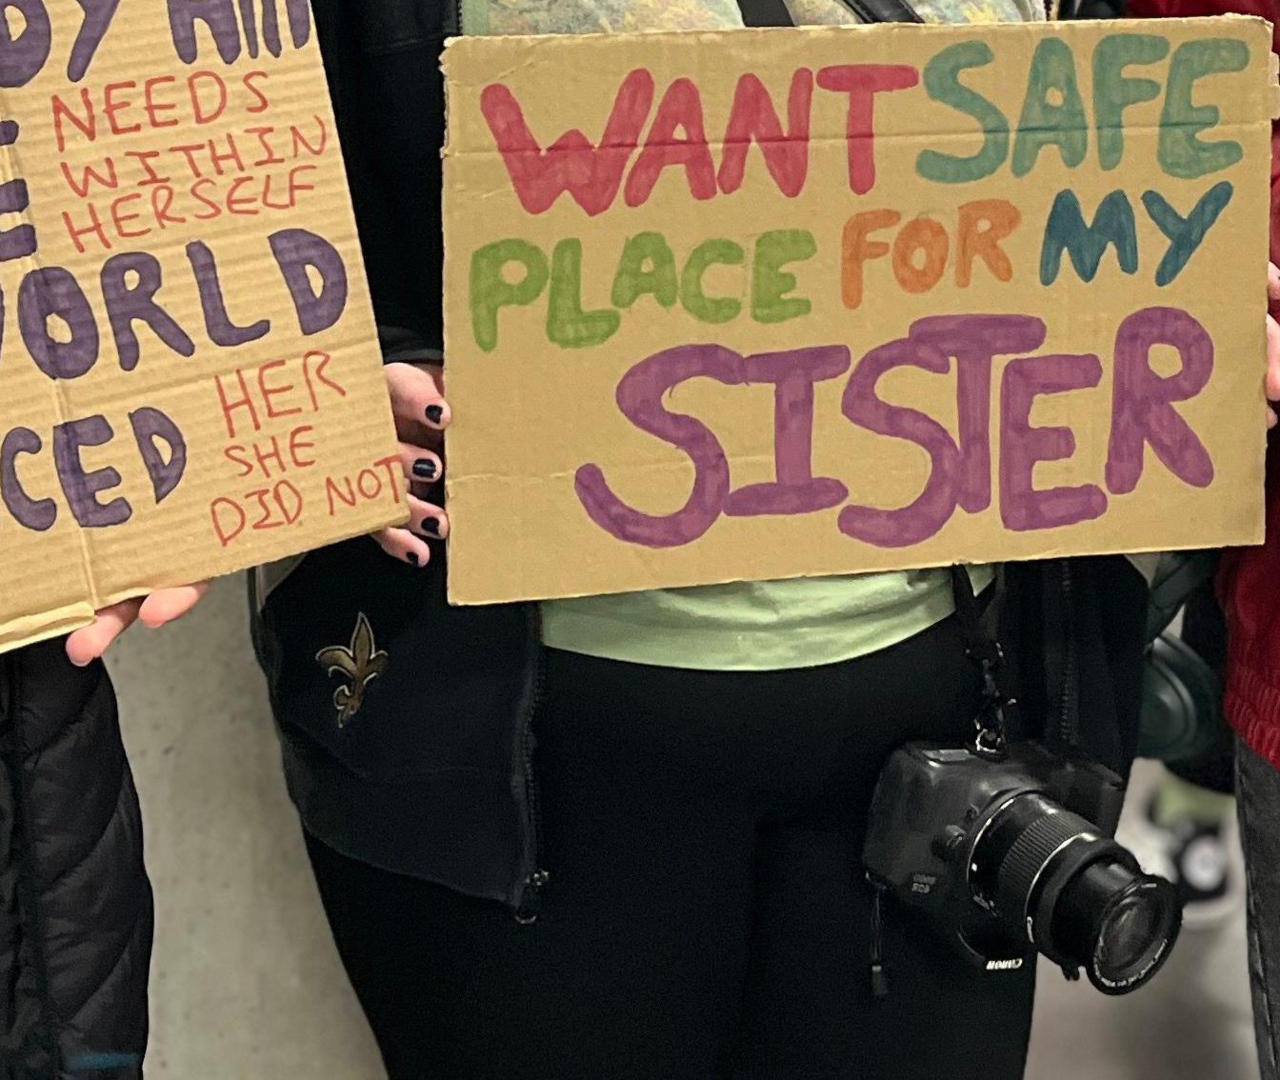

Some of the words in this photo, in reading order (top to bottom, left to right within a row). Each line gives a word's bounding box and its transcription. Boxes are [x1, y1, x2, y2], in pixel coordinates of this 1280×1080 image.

[52, 70, 272, 152] NEEDS
[480, 64, 918, 216] WANT
[916, 33, 1250, 183] SAFE
[60, 116, 328, 198] WITHIN
[63, 164, 320, 254] HERSELF
[468, 229, 817, 352] PLACE
[841, 199, 1021, 310] FOR
[1040, 181, 1234, 287] MY
[215, 350, 346, 439] HER
[575, 306, 1216, 549] SISTER
[224, 426, 317, 480] SHE
[210, 479, 305, 548] DID
[326, 454, 402, 518] NOT
